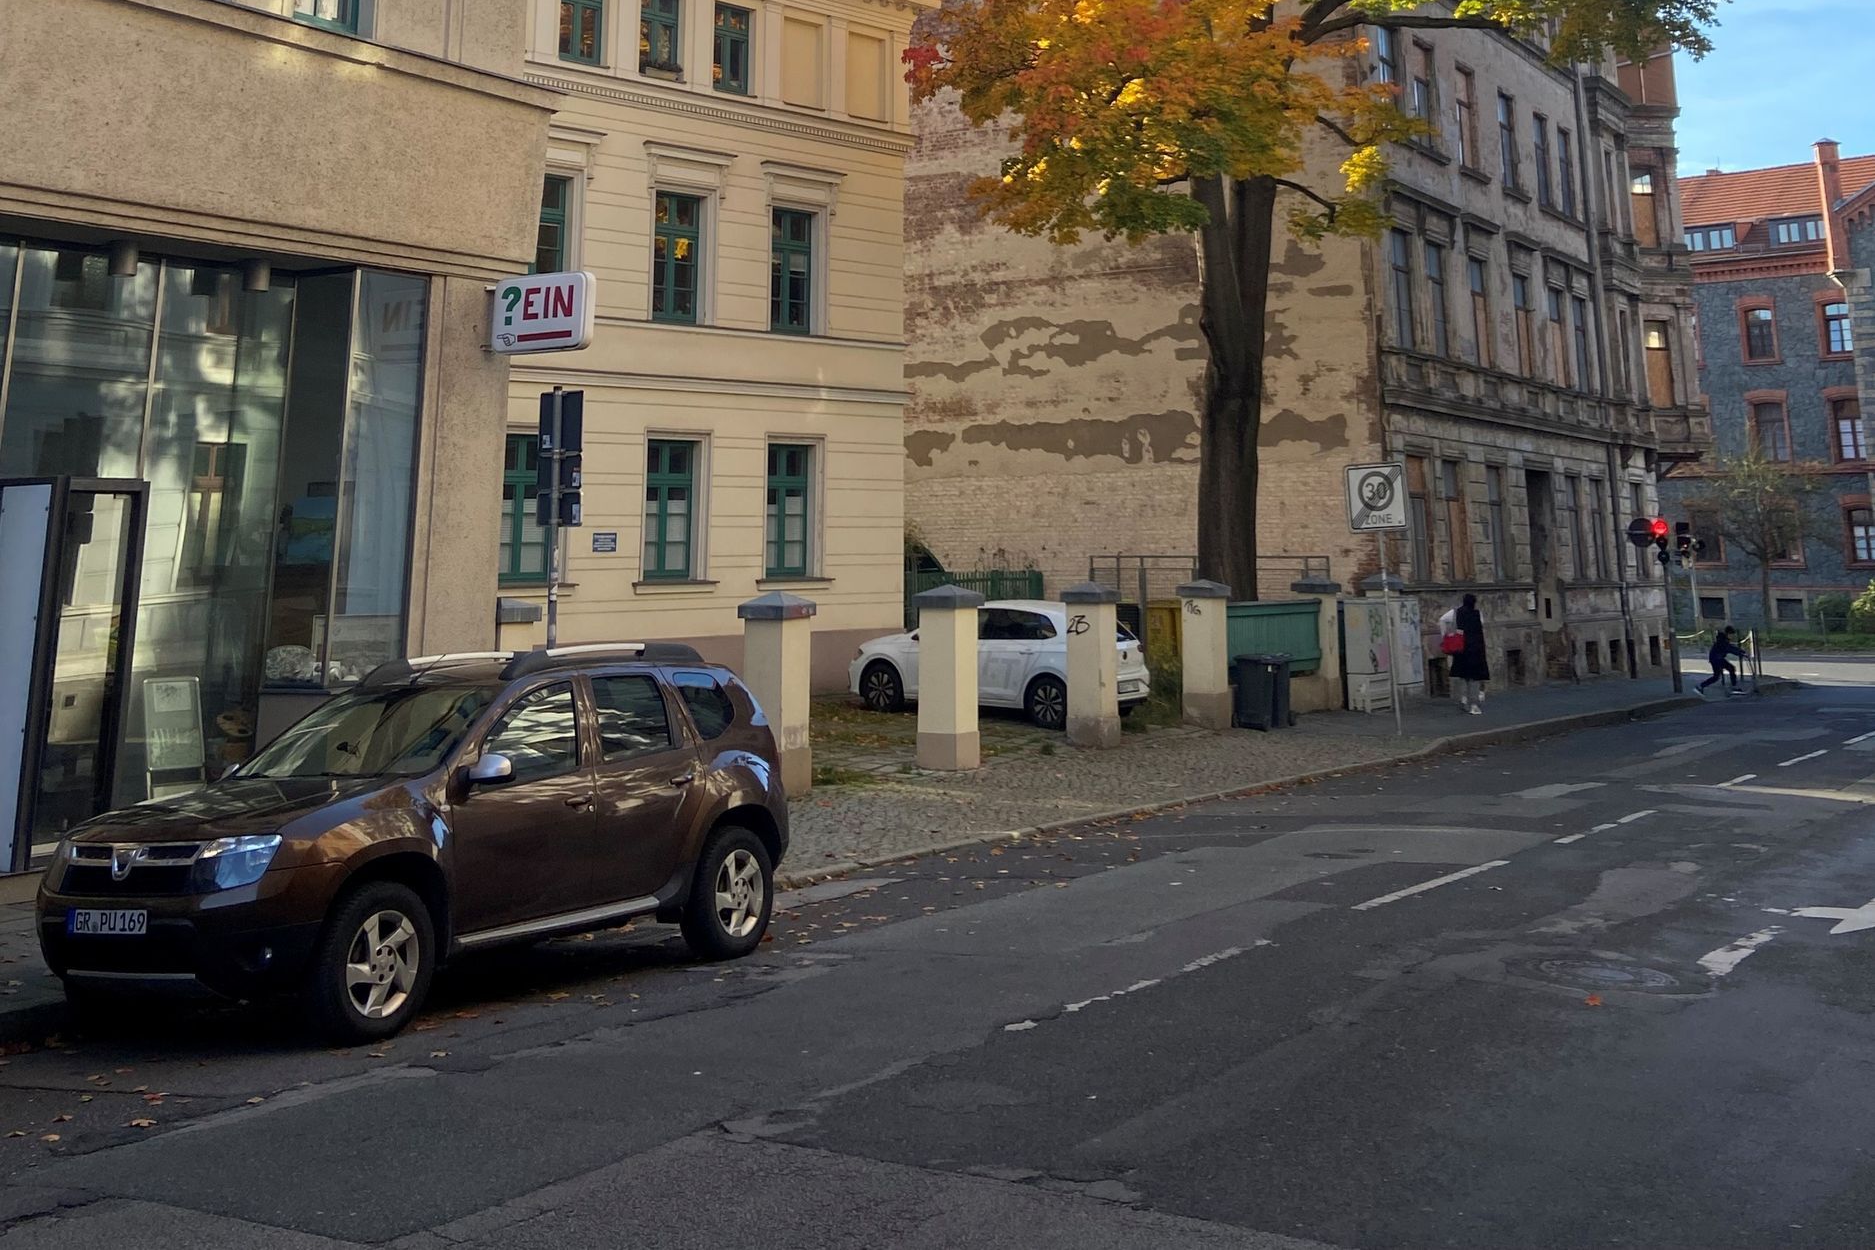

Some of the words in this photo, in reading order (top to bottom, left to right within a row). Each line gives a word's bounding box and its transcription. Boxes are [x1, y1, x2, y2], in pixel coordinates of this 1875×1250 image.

[1365, 482, 1387, 501] 30
[1365, 513, 1393, 525] ZONE
[75, 911, 91, 932] GR
